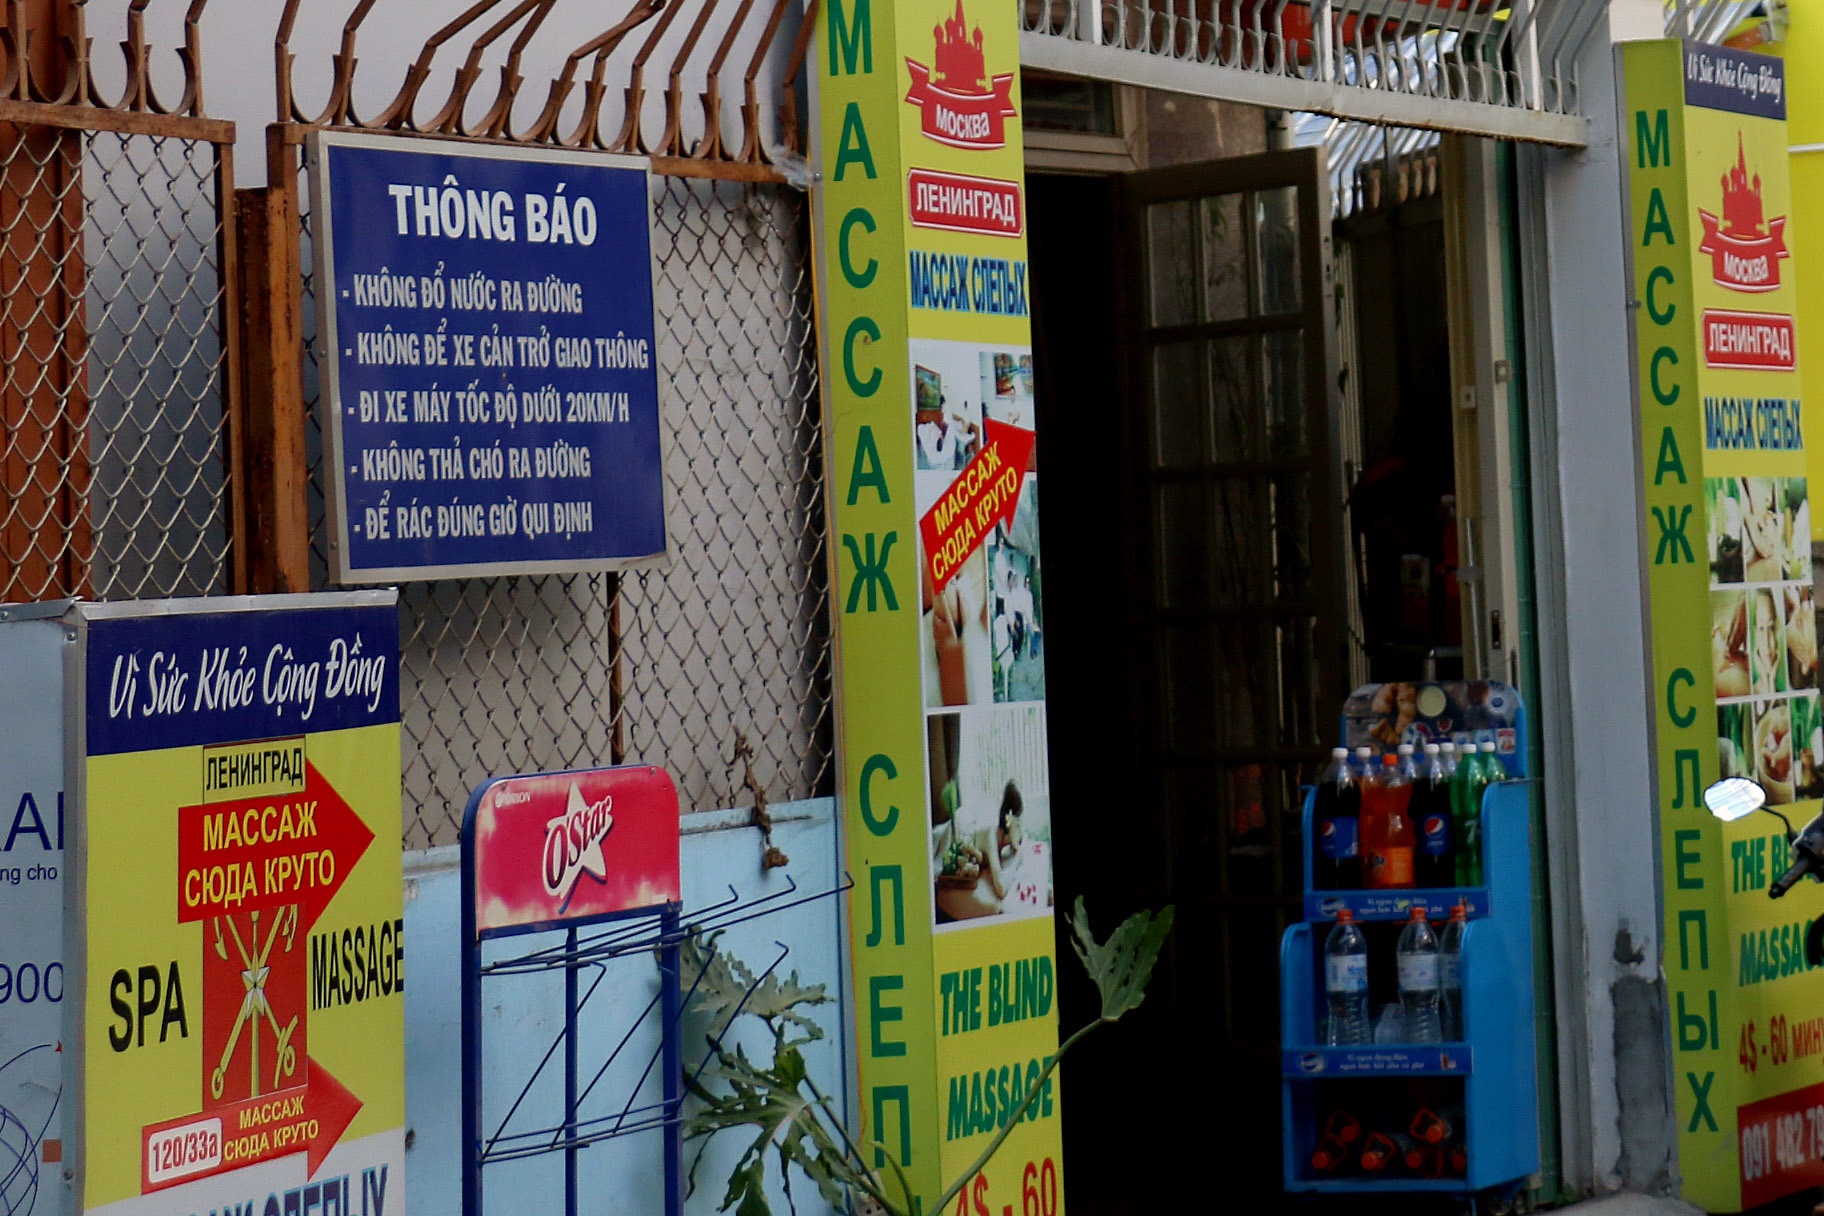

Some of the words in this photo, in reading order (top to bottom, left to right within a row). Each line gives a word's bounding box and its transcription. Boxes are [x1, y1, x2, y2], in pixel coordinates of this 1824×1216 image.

[388, 174, 517, 243] THÔNG
[525, 183, 598, 247] BÁO
[916, 182, 1018, 229] ЛЕНИНГРАД
[353, 266, 418, 308] KHÔNG
[421, 260, 446, 309] ĐỔ
[450, 269, 498, 311] NƯỚC
[501, 281, 524, 312] RA
[527, 273, 583, 314] ĐƯỜNG
[909, 249, 970, 311] МАССАЖ
[972, 255, 1029, 318] СЛЕПЫХ
[357, 324, 420, 366] KHÔNG
[424, 318, 449, 366] ĐỂ
[453, 334, 476, 366] XE
[479, 323, 515, 367] CẢN
[517, 325, 551, 368] TRỞ
[555, 337, 593, 369] GIAO
[595, 330, 650, 370] THÔNG
[1636, 109, 1696, 565] МАССАЖ
[1709, 322, 1792, 362] ЛЕНИНГРАД
[359, 390, 380, 423] ĐI
[384, 390, 408, 423] XE
[413, 382, 451, 423] MÁY
[455, 379, 491, 423] TỐC
[494, 384, 518, 429] ĐỘ
[522, 384, 562, 424] DƯỚI
[566, 391, 630, 424] 20KM/H
[1703, 396, 1757, 450] МАССАЖ
[1757, 397, 1804, 452] СЛЕПЫХ
[362, 440, 426, 481] KHÔNG
[429, 435, 465, 481] THẢ
[469, 439, 505, 481] CHÓ
[508, 448, 532, 480] RA
[535, 439, 592, 479] ĐƯỜNG
[365, 489, 391, 541] ĐỂ
[397, 495, 434, 539] RÁC
[437, 496, 486, 539] ĐÚNG
[489, 495, 519, 537] GIỜ
[522, 503, 550, 538] QUI
[553, 500, 594, 542] ĐỊNH
[933, 440, 1003, 536] МАССАЖ
[932, 515, 976, 582] СЮДА
[974, 466, 1019, 530] КРУТО
[143, 651, 190, 719] Sức
[193, 645, 257, 713] Khỏe
[262, 643, 320, 720] Cộng
[325, 632, 386, 713] Đồng
[206, 747, 304, 792] ЛЕНИНГРАД
[203, 800, 319, 852] МАССАЖ
[27, 863, 58, 882] cho
[185, 860, 259, 908] СЮДА
[264, 848, 337, 896] КРУТО
[1731, 836, 1766, 895] THE
[1667, 667, 1720, 1133] СЛЕПЫХ
[311, 918, 405, 1012] MASSAGE
[108, 960, 190, 1054] SPA
[940, 966, 983, 1037] THE
[988, 955, 1054, 1028] BLIND
[1739, 1018, 1758, 1074] 4$
[1770, 1013, 1788, 1066] 60
[239, 1094, 306, 1131] МАССАЖ
[946, 1054, 1055, 1142] MASSAGE
[152, 1129, 219, 1173] 120/33a
[224, 1136, 270, 1162] СЮДА
[273, 1119, 320, 1151] КРУТО
[1742, 1121, 1772, 1182] 091
[1023, 1155, 1058, 1216] 60
